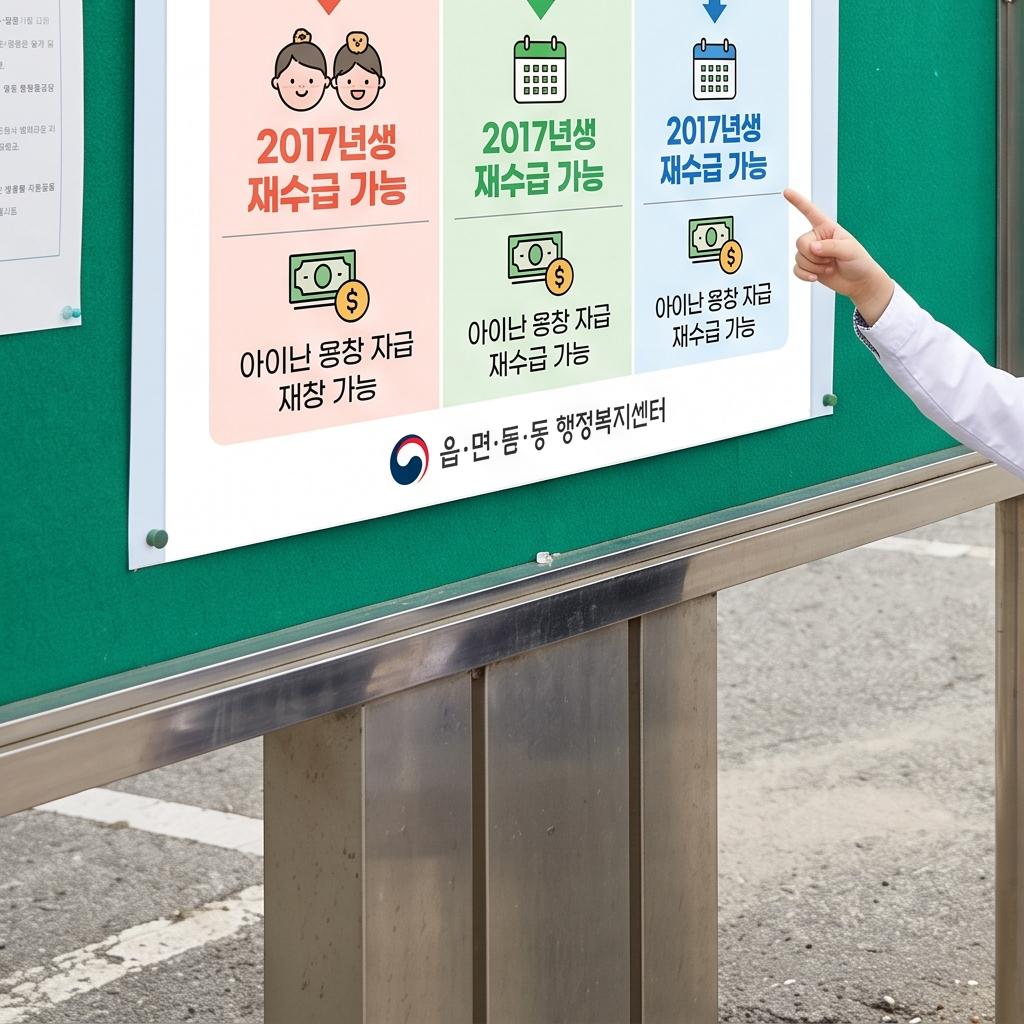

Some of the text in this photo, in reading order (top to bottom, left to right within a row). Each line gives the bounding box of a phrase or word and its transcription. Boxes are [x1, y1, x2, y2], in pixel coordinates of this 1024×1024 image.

[257, 123, 396, 164] 2017년생
[482, 117, 596, 154] 2017년생
[666, 112, 762, 146] 2017년생
[474, 159, 604, 198] 재수급 가능
[660, 150, 768, 185] 재수급 가능
[247, 169, 407, 214] 재수급 가능
[655, 291, 704, 319] 아이난
[468, 313, 527, 346] 아이난
[574, 303, 611, 331] 자급
[672, 316, 756, 348] 재수급 가능
[240, 342, 312, 379] 아이난
[370, 330, 414, 361] 자급
[489, 341, 590, 378] 재수급 가능
[278, 374, 377, 412] 재창 가능
[556, 396, 666, 445] 행정복지센터
